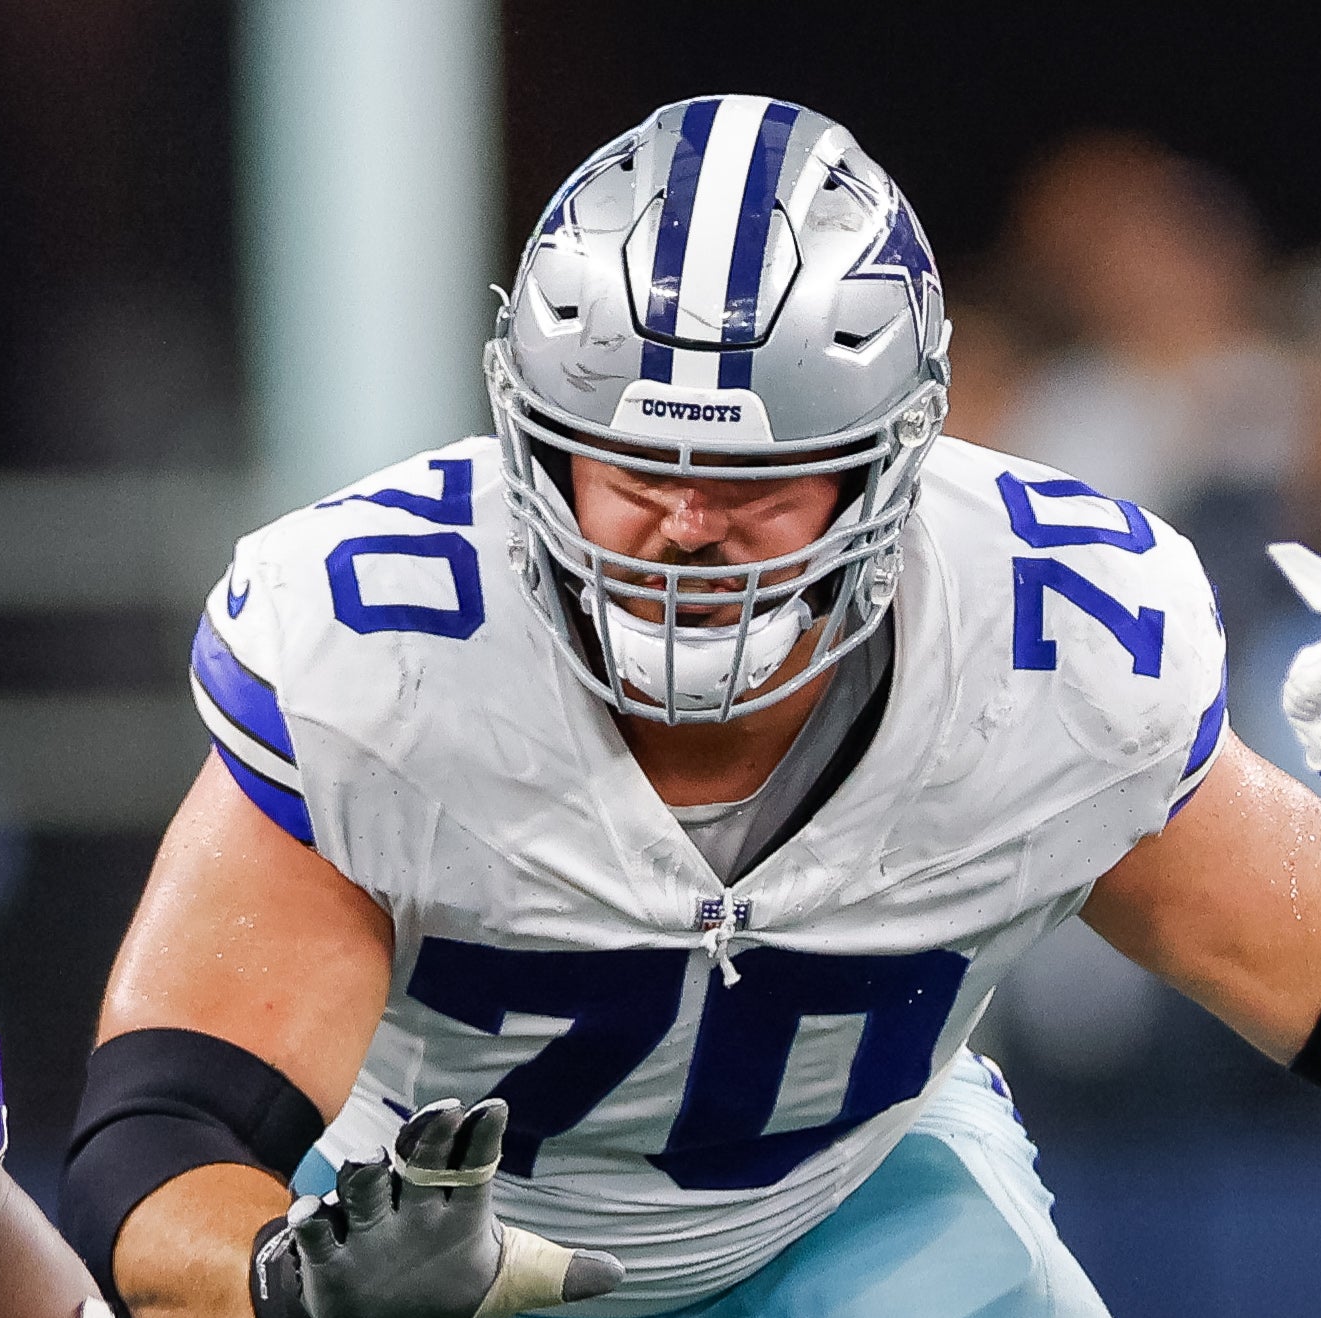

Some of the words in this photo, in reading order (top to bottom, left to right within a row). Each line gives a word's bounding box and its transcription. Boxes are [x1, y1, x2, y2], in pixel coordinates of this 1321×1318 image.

[642, 399, 742, 423] COWBOYS
[314, 458, 486, 640] 70
[995, 470, 1166, 680] 70
[382, 936, 972, 1191] 70
